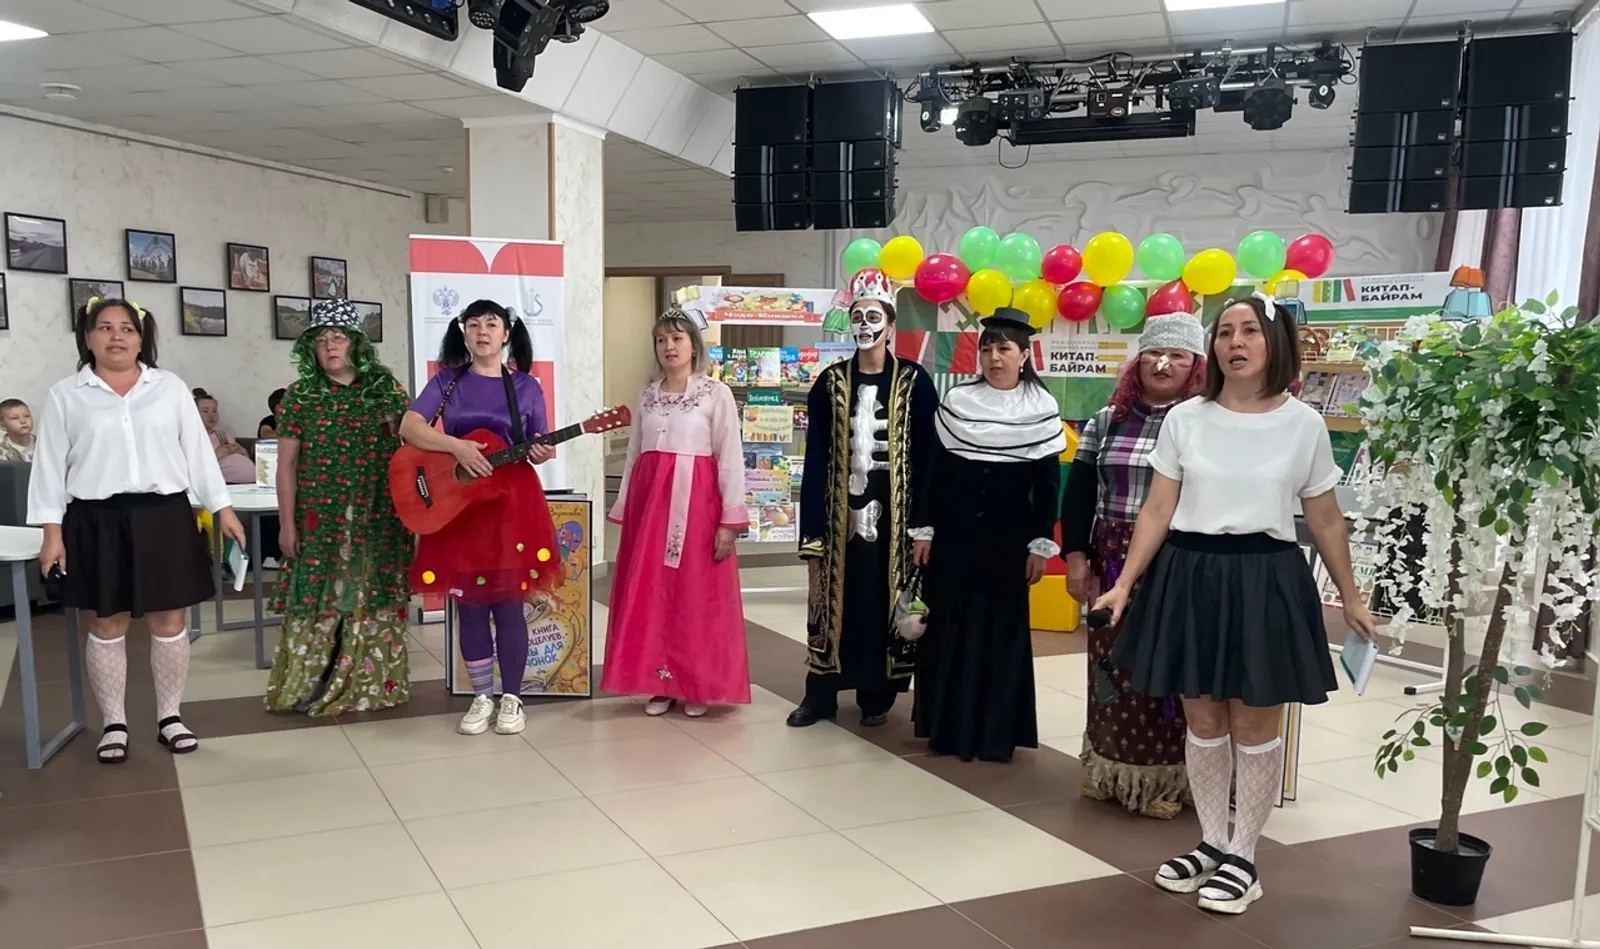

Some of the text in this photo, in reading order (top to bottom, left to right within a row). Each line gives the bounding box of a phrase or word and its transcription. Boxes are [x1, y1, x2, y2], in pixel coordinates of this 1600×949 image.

[1361, 284, 1414, 292] КИТАП-
[1361, 292, 1422, 301] БАЙРАМ
[1050, 352, 1099, 361] КИТАП-
[1050, 362, 1106, 373] БАЙРАМ
[532, 624, 560, 636] КНИГА
[528, 632, 565, 647] ОЦЕЛУЕВ.
[545, 641, 564, 656] ДЛЯ
[526, 653, 559, 668] ЧОНОК
